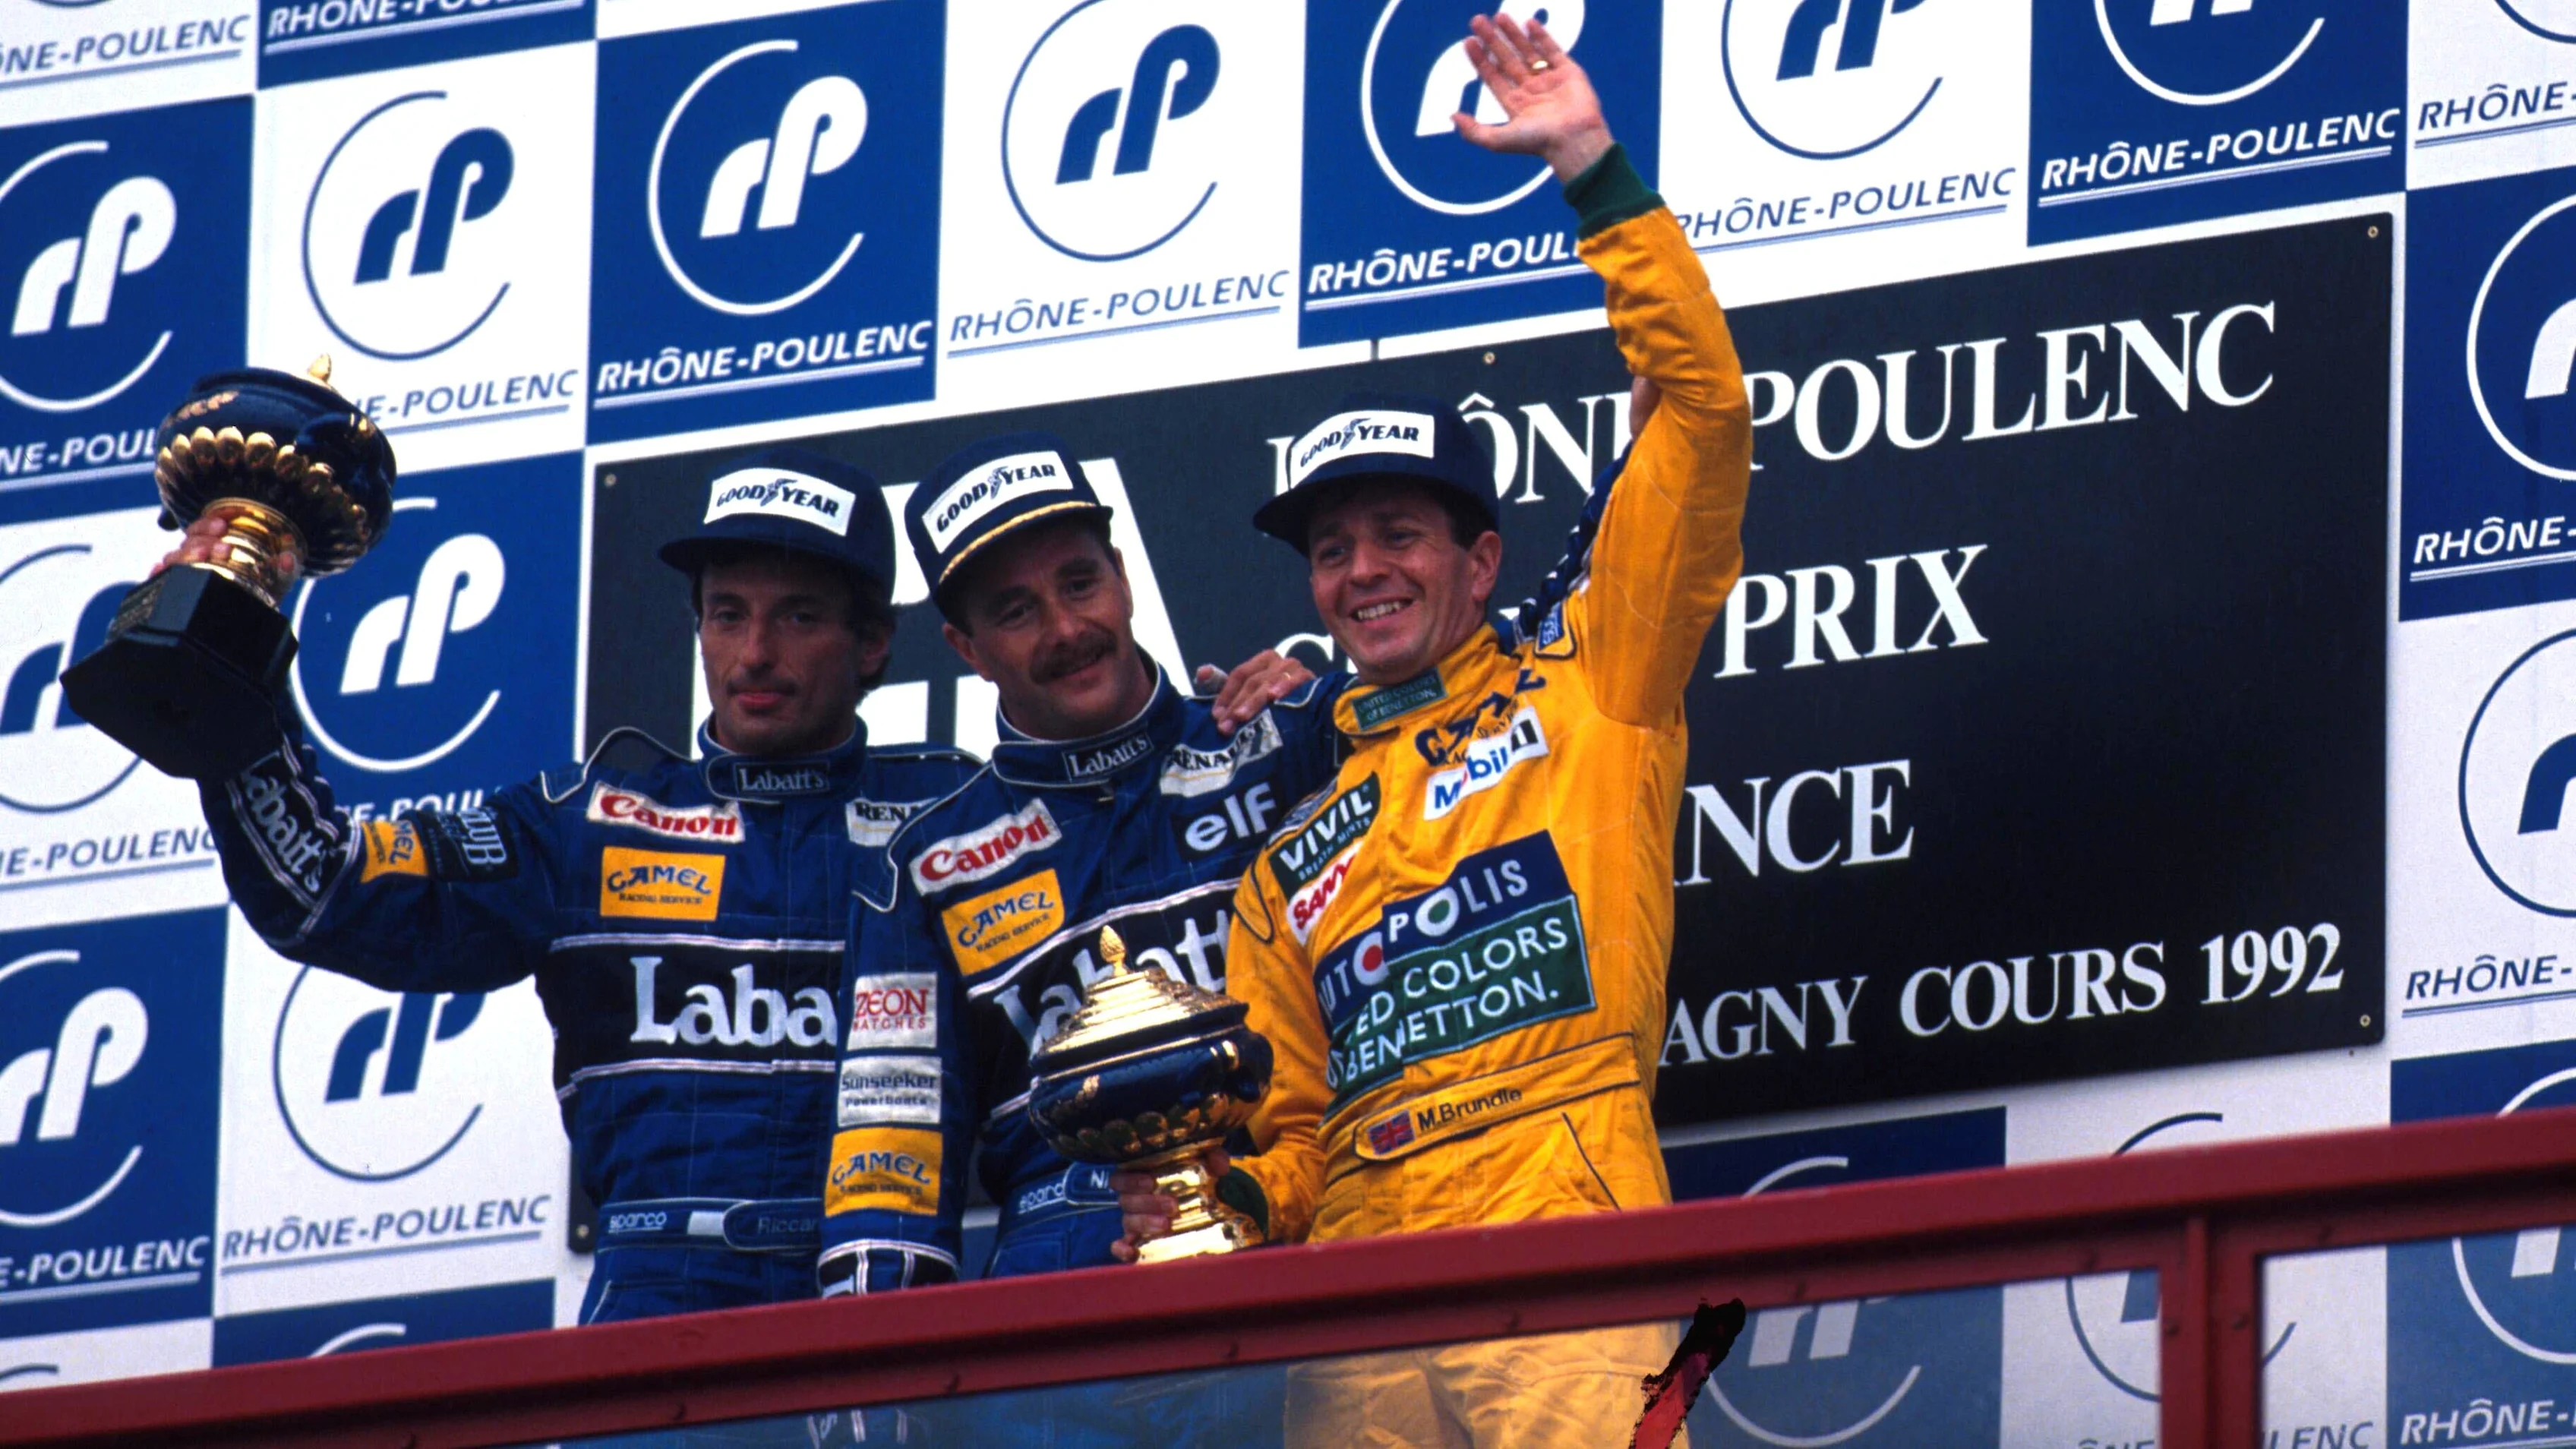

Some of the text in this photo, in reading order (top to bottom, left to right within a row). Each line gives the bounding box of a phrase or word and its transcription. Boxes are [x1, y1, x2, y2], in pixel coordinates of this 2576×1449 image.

[0, 14, 250, 74] NE-POULENC
[2041, 109, 2401, 191] RHÔNE-POULENC
[1308, 232, 1578, 294] RHÔNE-POUL
[949, 270, 1290, 343] RHÔNE-POULENC
[596, 320, 933, 393] RHÔNE-POULENC
[356, 369, 579, 422] E-POULENC
[1714, 545, 1989, 678] PRIX
[737, 766, 826, 791] Labatt's
[1068, 734, 1148, 778] Labatt's
[600, 794, 737, 835] Canon
[1185, 781, 1277, 851] elf
[1279, 791, 1373, 871] VIVIL
[1337, 816, 1371, 844] MINTS
[1674, 760, 1915, 889] NCE
[920, 814, 1050, 882] Canon
[608, 864, 712, 895] CAMEL
[957, 890, 1055, 948] CAMEL
[1404, 917, 1568, 999] COLORS
[629, 956, 838, 1047] Laba
[854, 989, 929, 1018] ZEON
[1660, 922, 2344, 1066] AGNY COURS 1992
[841, 1073, 937, 1091] Sunseeker
[832, 1151, 931, 1185] CAMEL
[223, 1195, 551, 1261] RHÔNE-POULENC
[609, 1211, 668, 1233] sparco
[758, 1217, 817, 1234] Riccar
[2401, 1398, 2576, 1444] RHÔNE-
